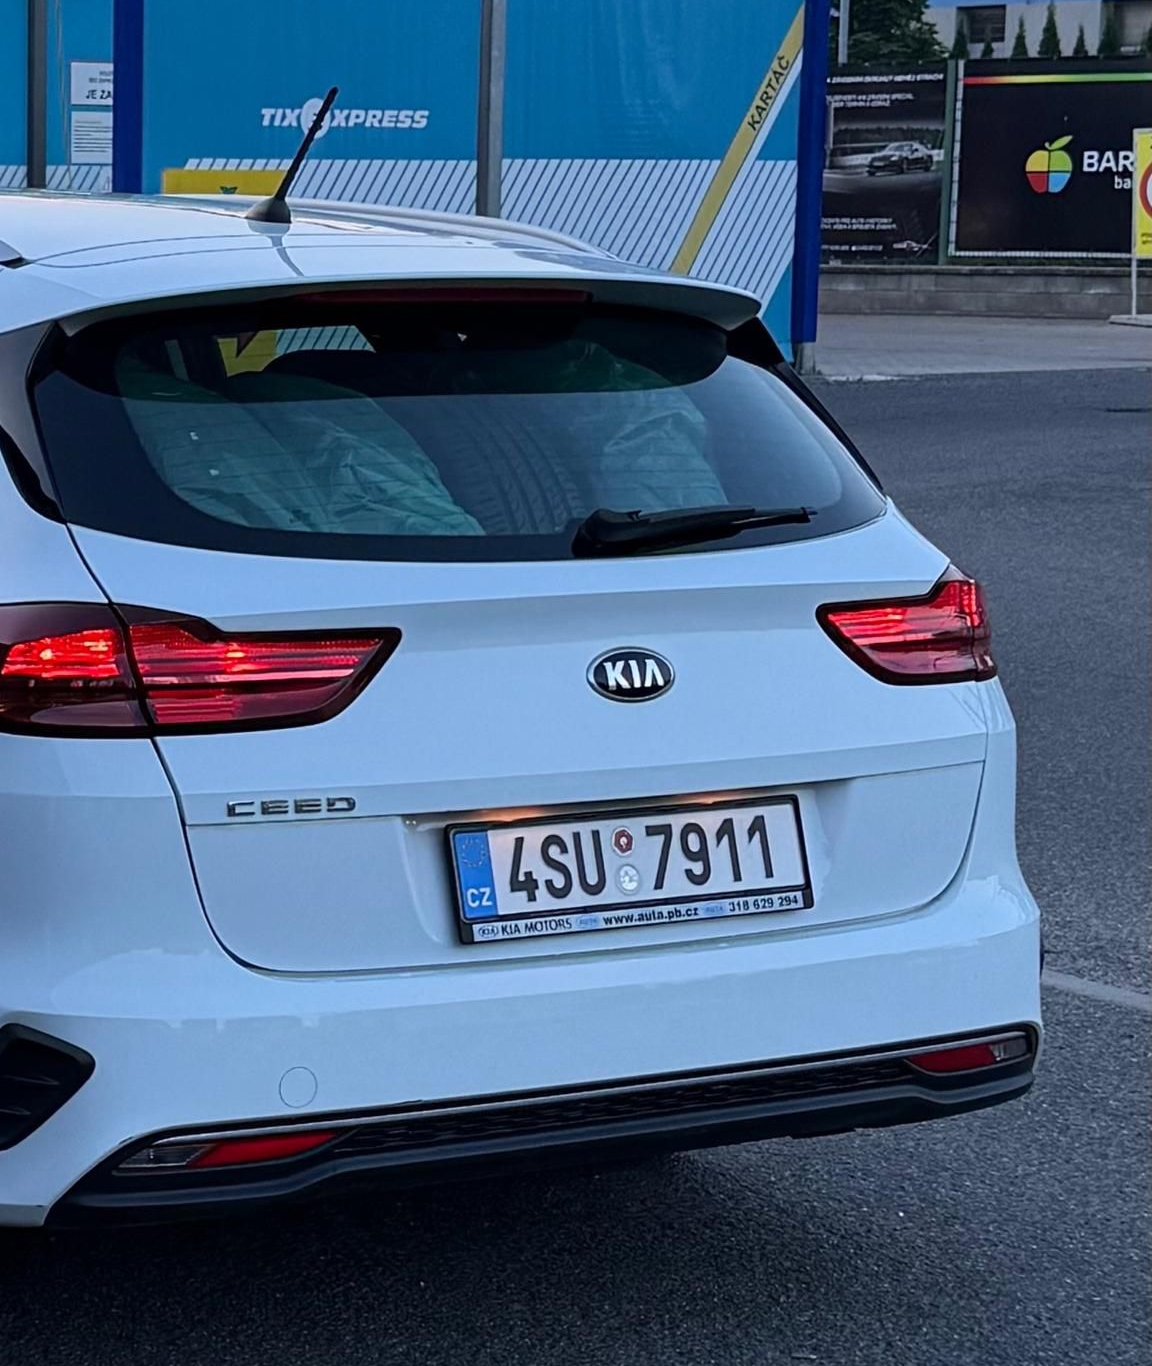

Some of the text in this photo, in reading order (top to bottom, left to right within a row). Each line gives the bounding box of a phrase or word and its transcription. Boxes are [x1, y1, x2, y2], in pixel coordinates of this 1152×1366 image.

[602, 656, 667, 692] KIA
[226, 797, 357, 817] CEED
[509, 814, 775, 903] 4SU 7911
[466, 887, 494, 908] CZ
[500, 924, 521, 936] KIA
[524, 918, 573, 934] MOTORS
